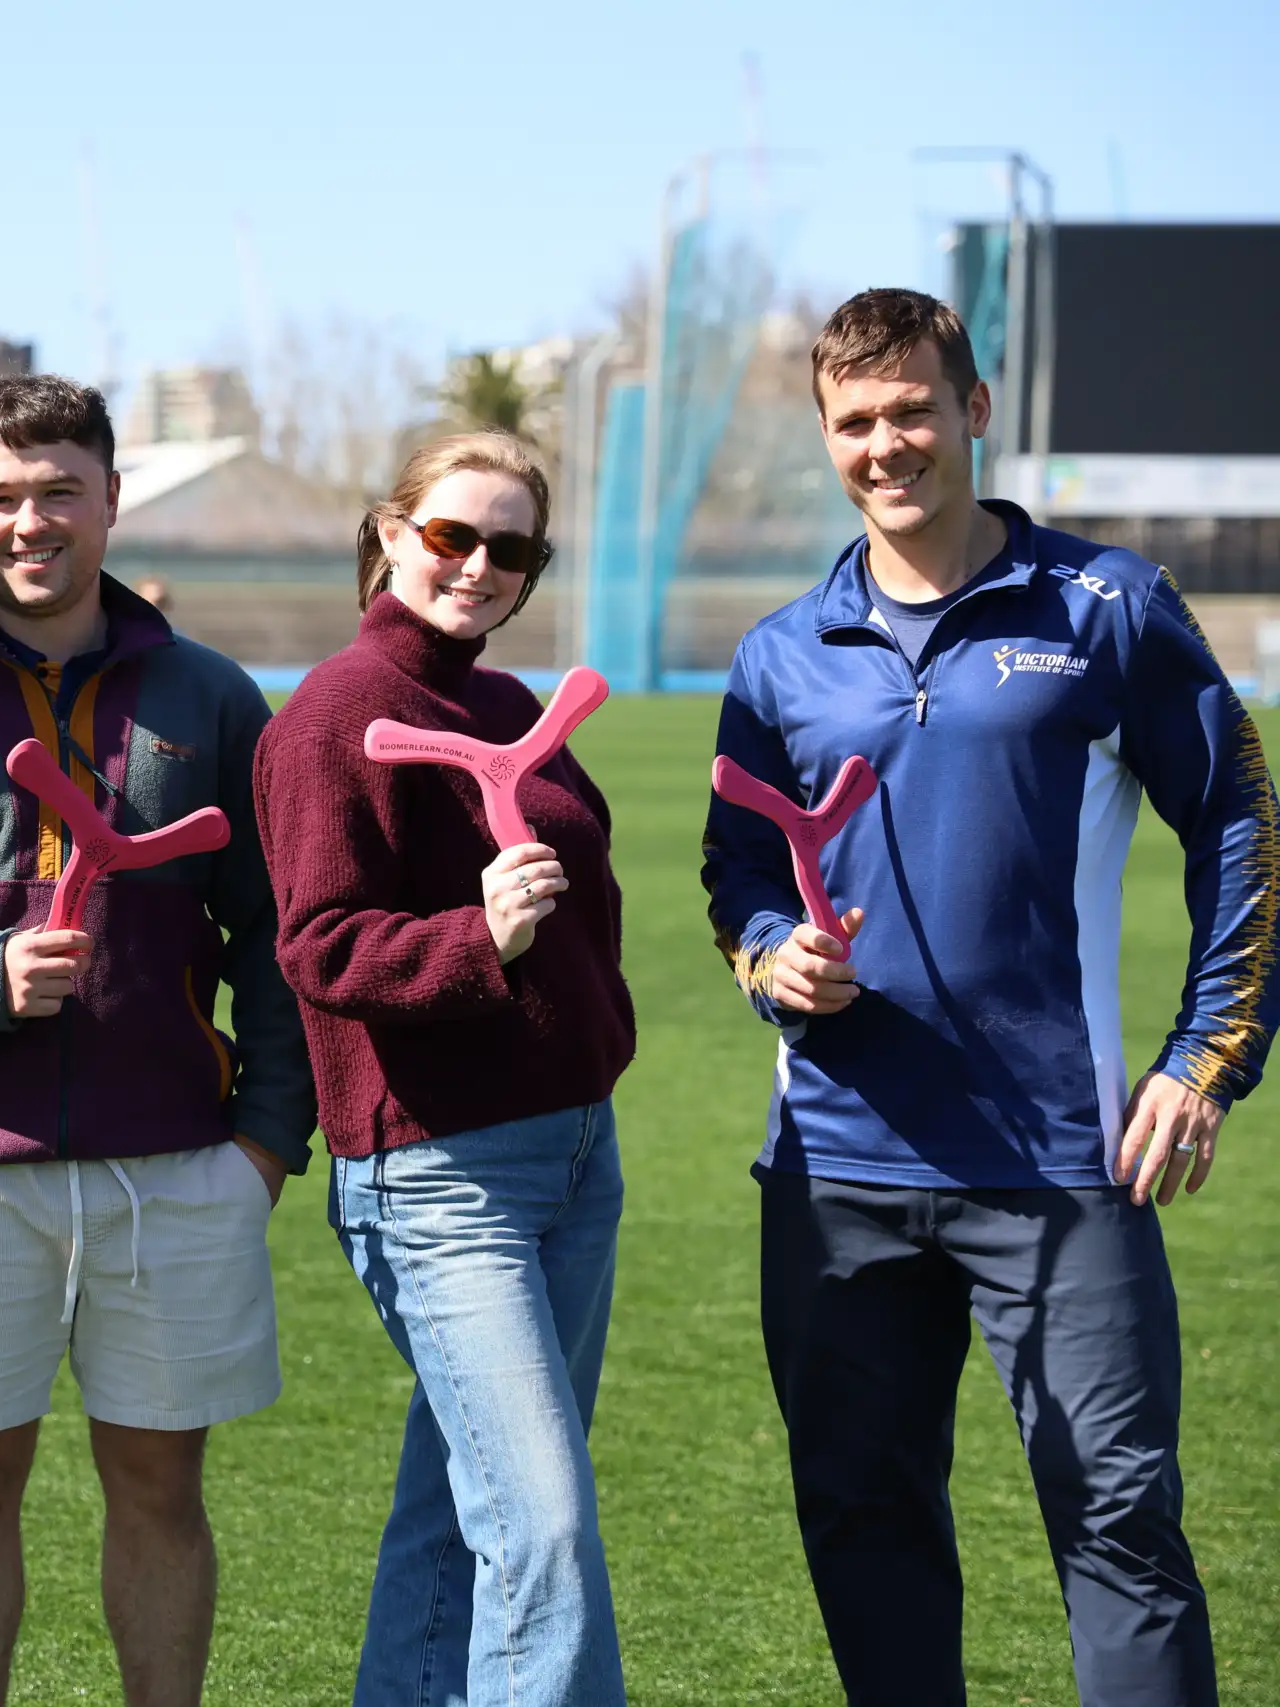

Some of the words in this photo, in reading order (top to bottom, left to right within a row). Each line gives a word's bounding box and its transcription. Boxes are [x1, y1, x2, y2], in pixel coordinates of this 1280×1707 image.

[1047, 563, 1122, 601] 2XU
[1013, 664, 1051, 673] INSTITUTE
[1052, 666, 1063, 674] OF
[1015, 652, 1089, 671] VICTORIAN
[379, 743, 476, 762] BOOMERLEARN.COM.AU
[64, 875, 87, 928] EARN.COM.AU
